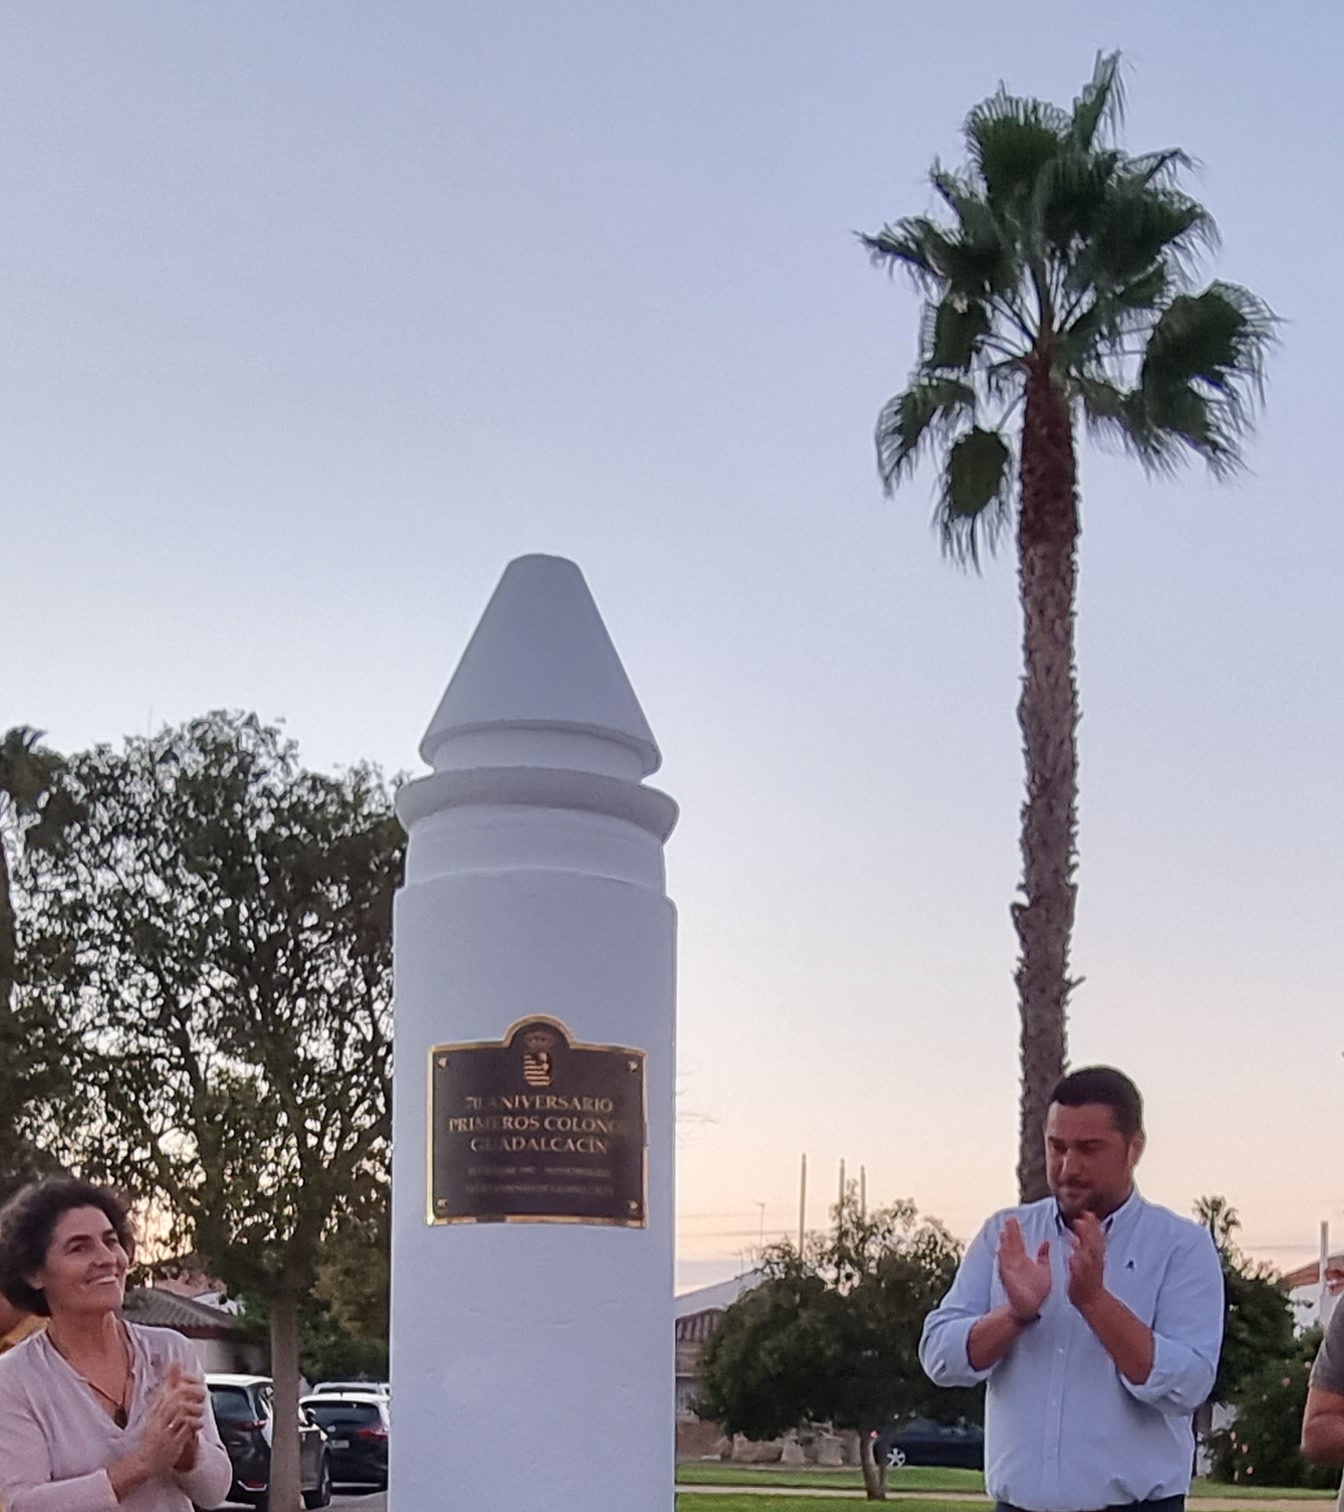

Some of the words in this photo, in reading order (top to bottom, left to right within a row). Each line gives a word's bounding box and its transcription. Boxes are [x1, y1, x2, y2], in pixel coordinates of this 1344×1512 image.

[488, 1095, 614, 1113] NIVERSARIO
[449, 1115, 540, 1131] PRIMROS
[544, 1116, 617, 1133] COLON
